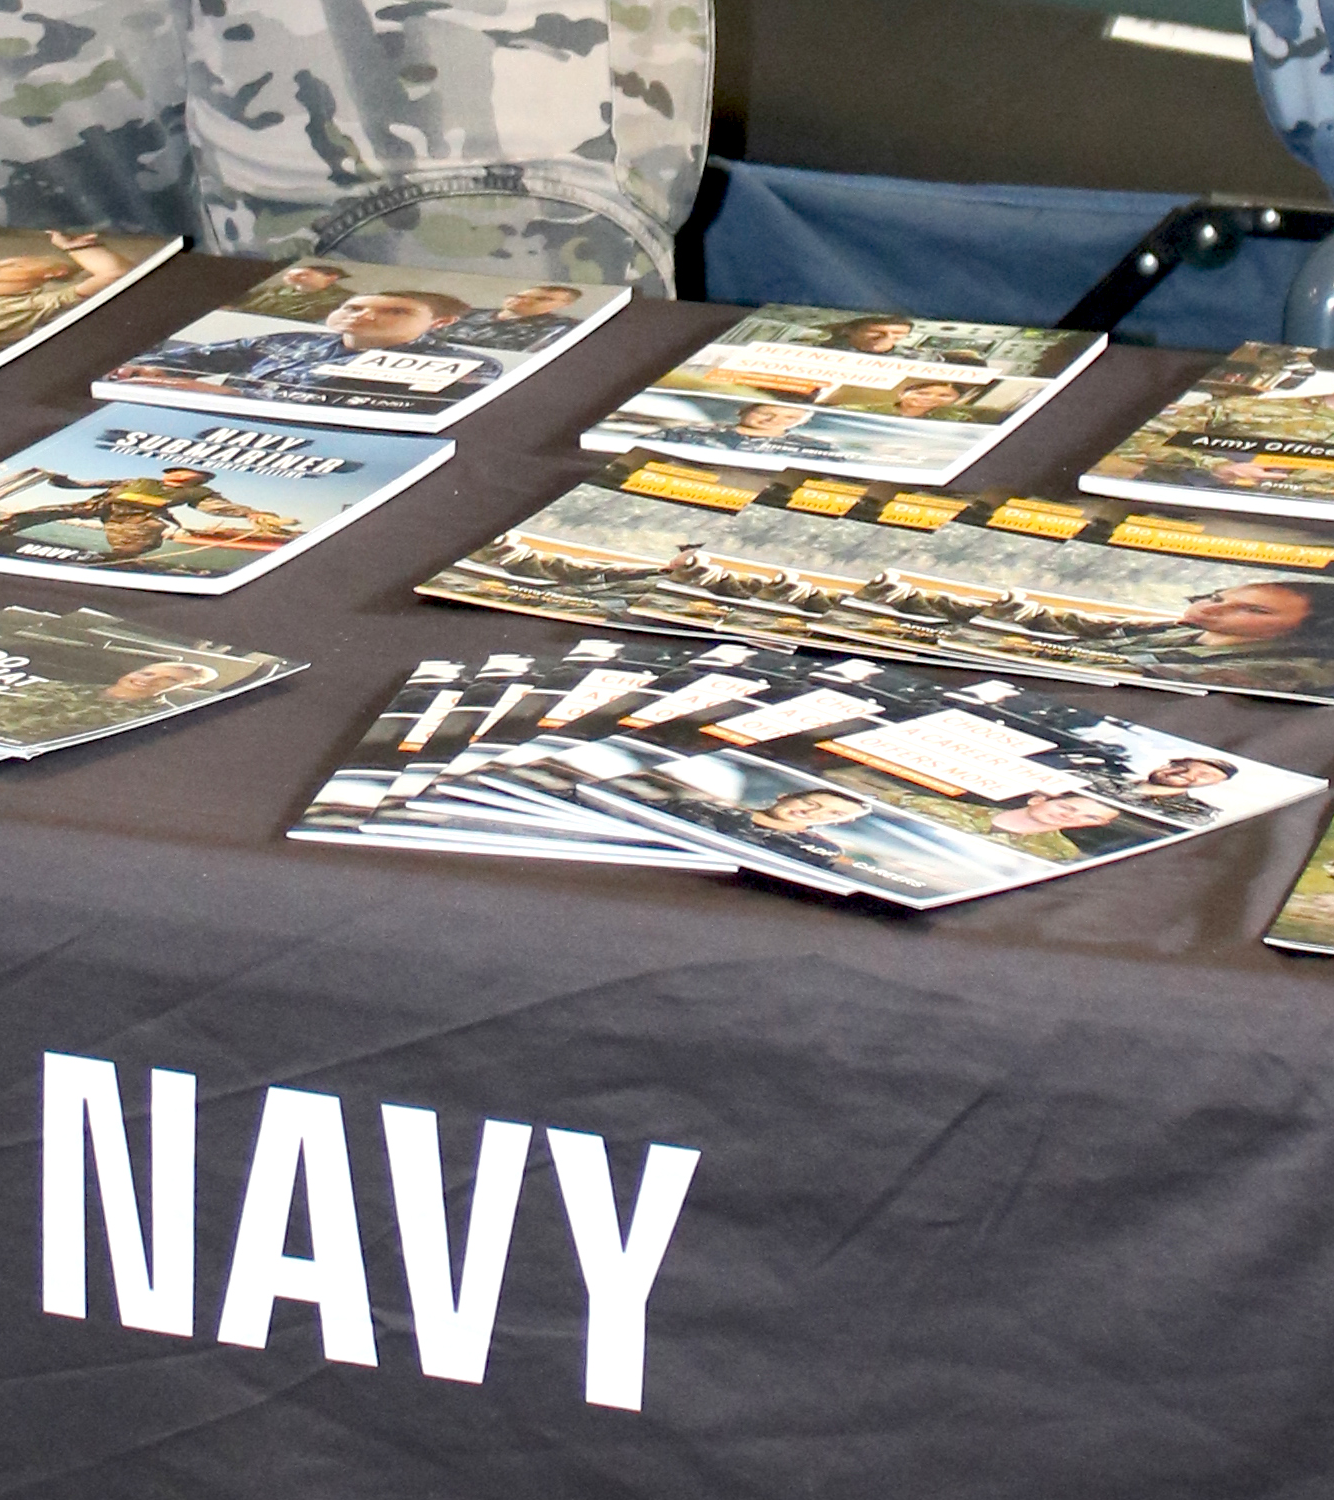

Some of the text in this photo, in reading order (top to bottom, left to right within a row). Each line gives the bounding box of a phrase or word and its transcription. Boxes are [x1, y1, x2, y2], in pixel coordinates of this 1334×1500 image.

[361, 355, 462, 375] ADFA
[737, 359, 890, 385] SPONSORSHIP
[756, 346, 985, 381] DEFENCE UNIVERSITY
[116, 431, 346, 474] SUBMARINER
[206, 427, 307, 451] NAVY
[1192, 434, 1258, 450] Army
[15, 543, 80, 560] NAVY
[1117, 535, 1319, 567] and your community
[1125, 525, 1153, 538] Do
[1156, 531, 1259, 552] something
[1263, 541, 1294, 552] for
[942, 714, 1036, 750] CHOOSE
[859, 736, 942, 770] OFFERS
[942, 765, 1010, 793] MORE
[906, 727, 920, 737] A
[921, 731, 1009, 768] CAREER
[1011, 759, 1067, 788] THAT
[799, 844, 927, 888] ADF CAREERS
[41, 1050, 701, 1412] NAVY
